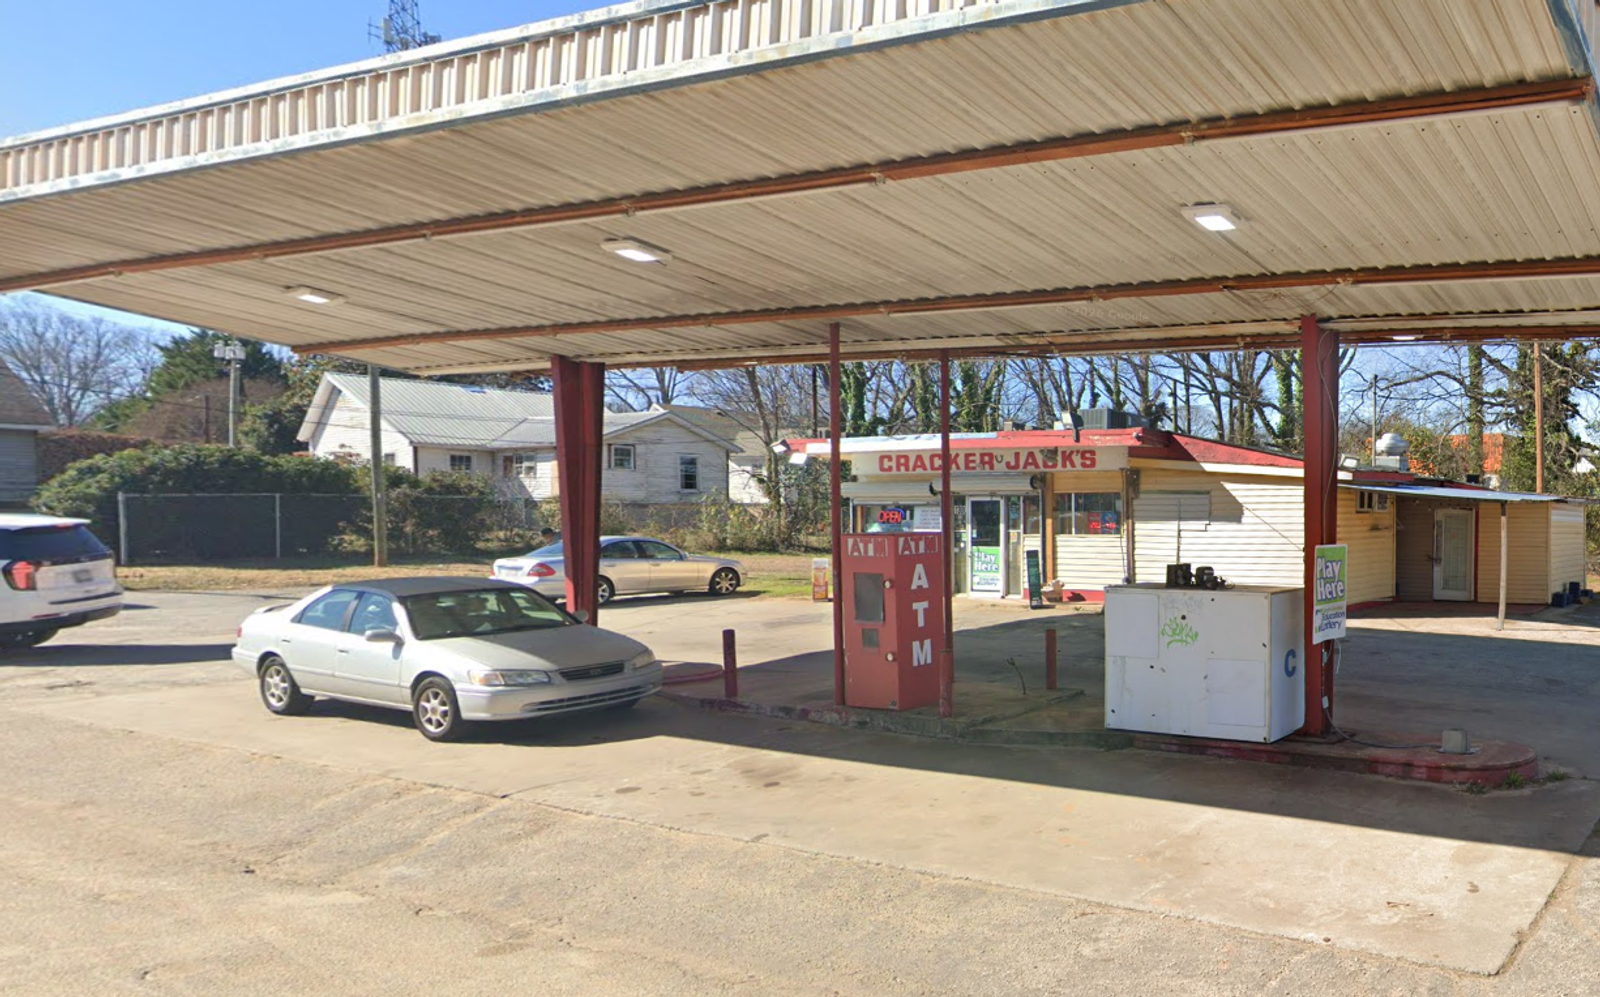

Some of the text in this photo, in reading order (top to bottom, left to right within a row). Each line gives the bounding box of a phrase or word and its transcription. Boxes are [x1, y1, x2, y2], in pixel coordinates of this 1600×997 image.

[878, 451, 995, 473] CRACKER
[878, 510, 902, 523] OPEN
[974, 551, 997, 563] Play
[974, 561, 999, 572] Here
[1317, 557, 1342, 581] Play
[1317, 578, 1345, 601] Here
[910, 563, 933, 668] ATM
